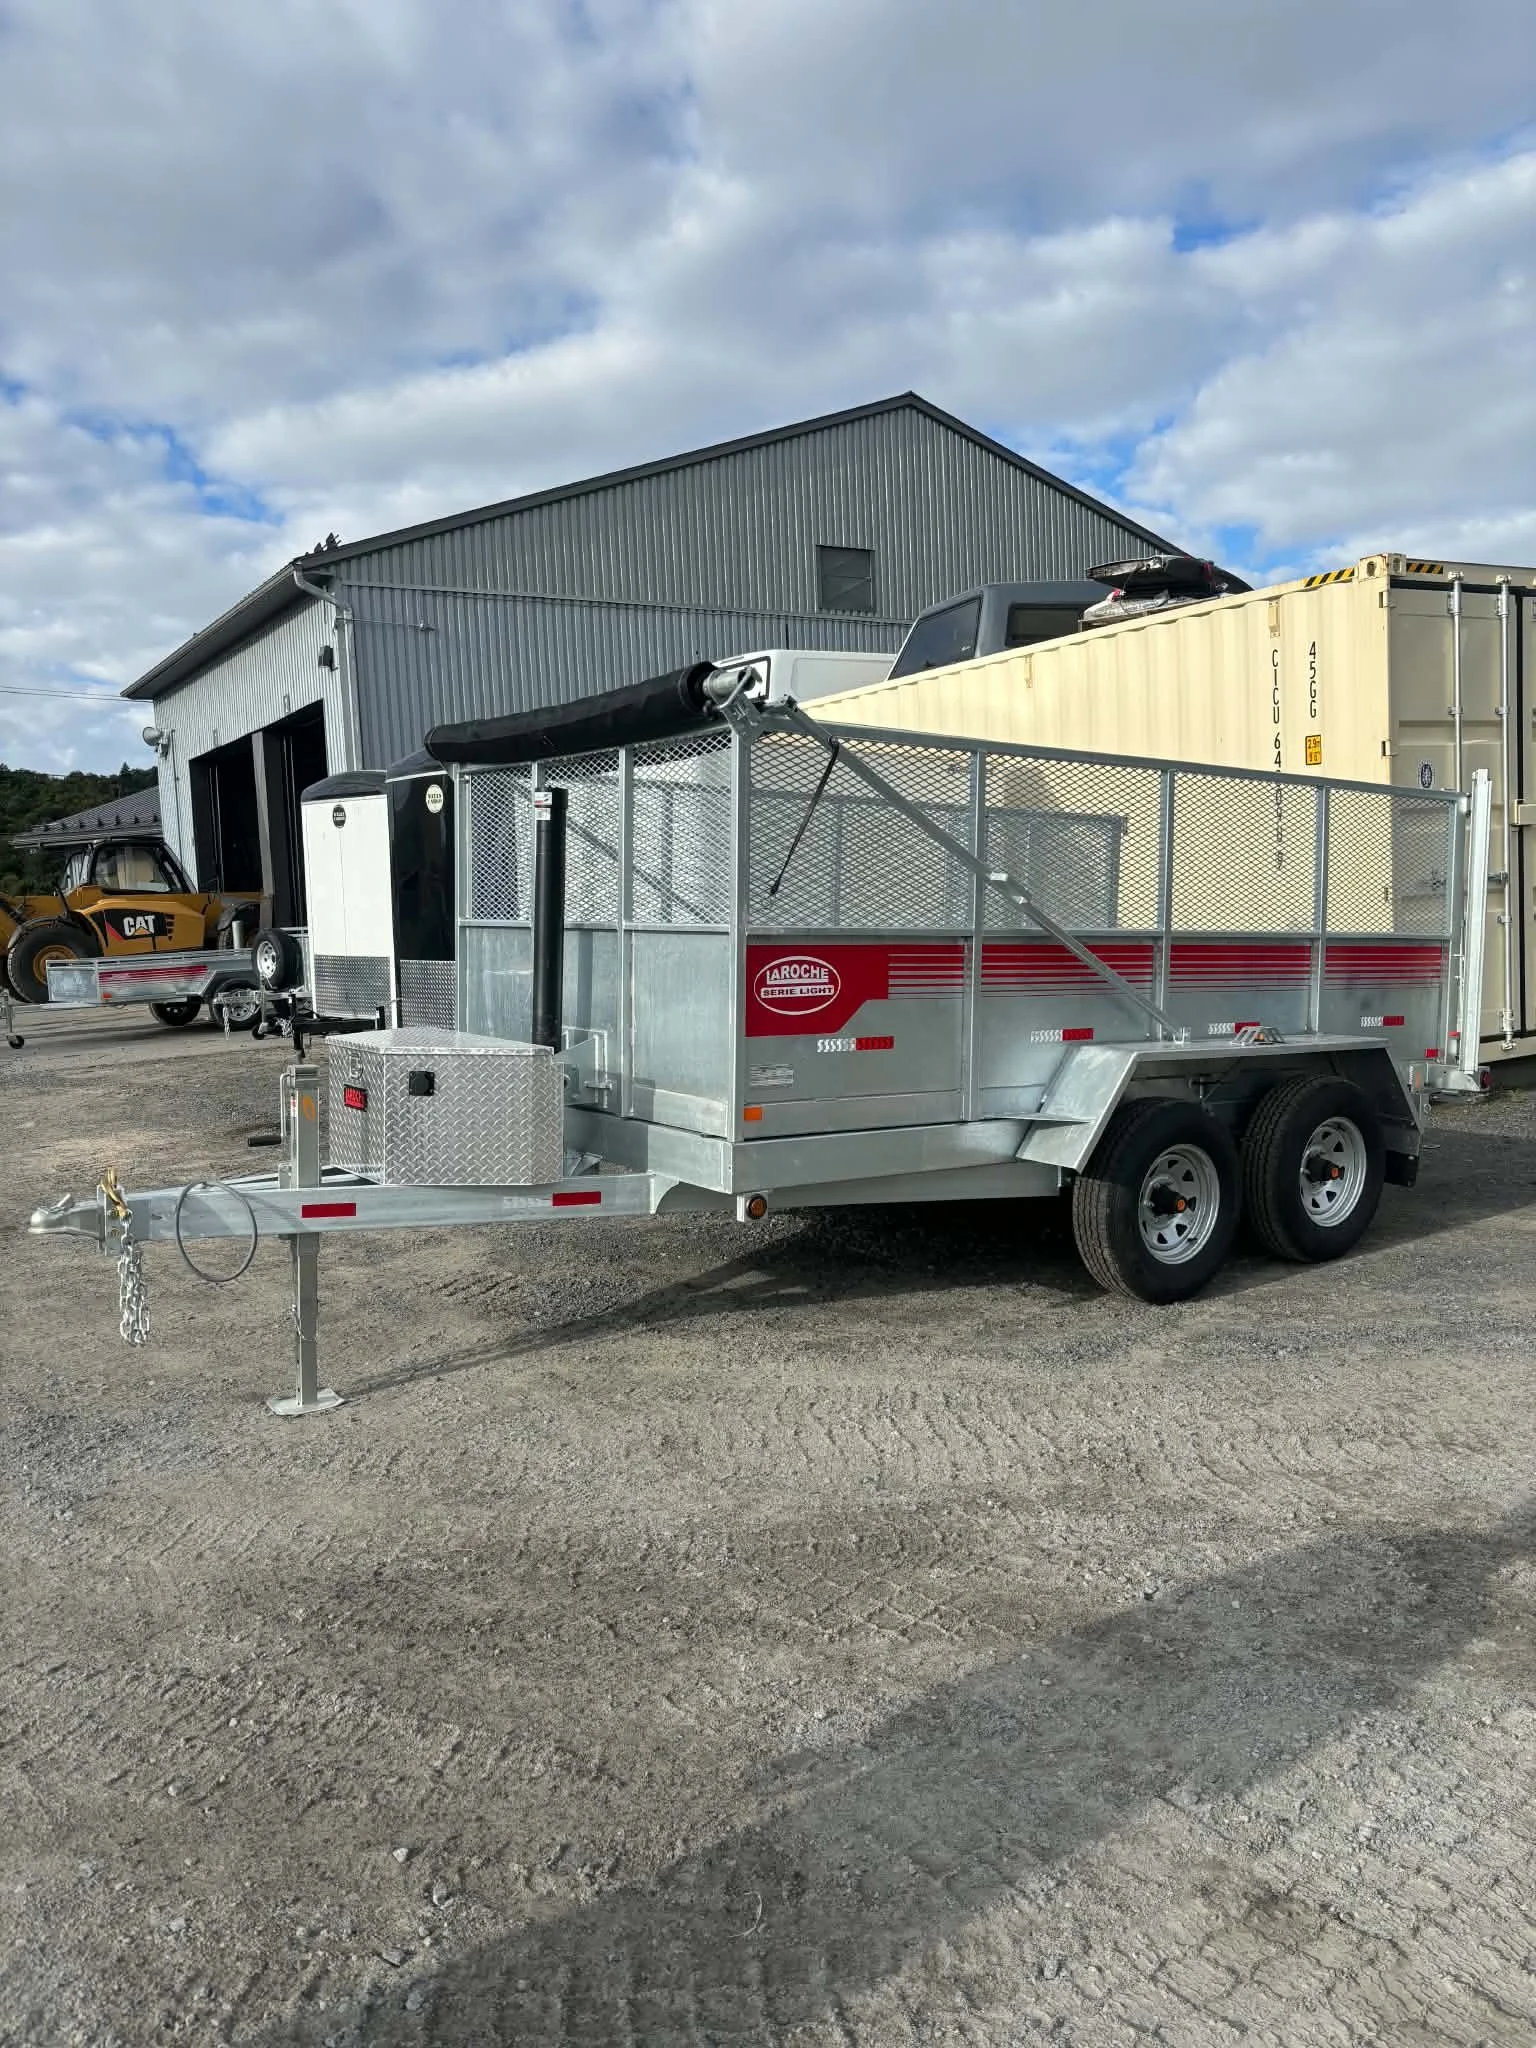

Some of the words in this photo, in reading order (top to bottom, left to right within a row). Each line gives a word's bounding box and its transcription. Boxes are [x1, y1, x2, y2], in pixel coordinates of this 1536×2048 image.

[1271, 648, 1280, 724] CICU
[1308, 640, 1317, 718] 45GG
[123, 915, 155, 936] CAT
[766, 964, 829, 984] LAROCHE
[762, 988, 797, 997] SERIE
[799, 986, 833, 995] LIGHT
